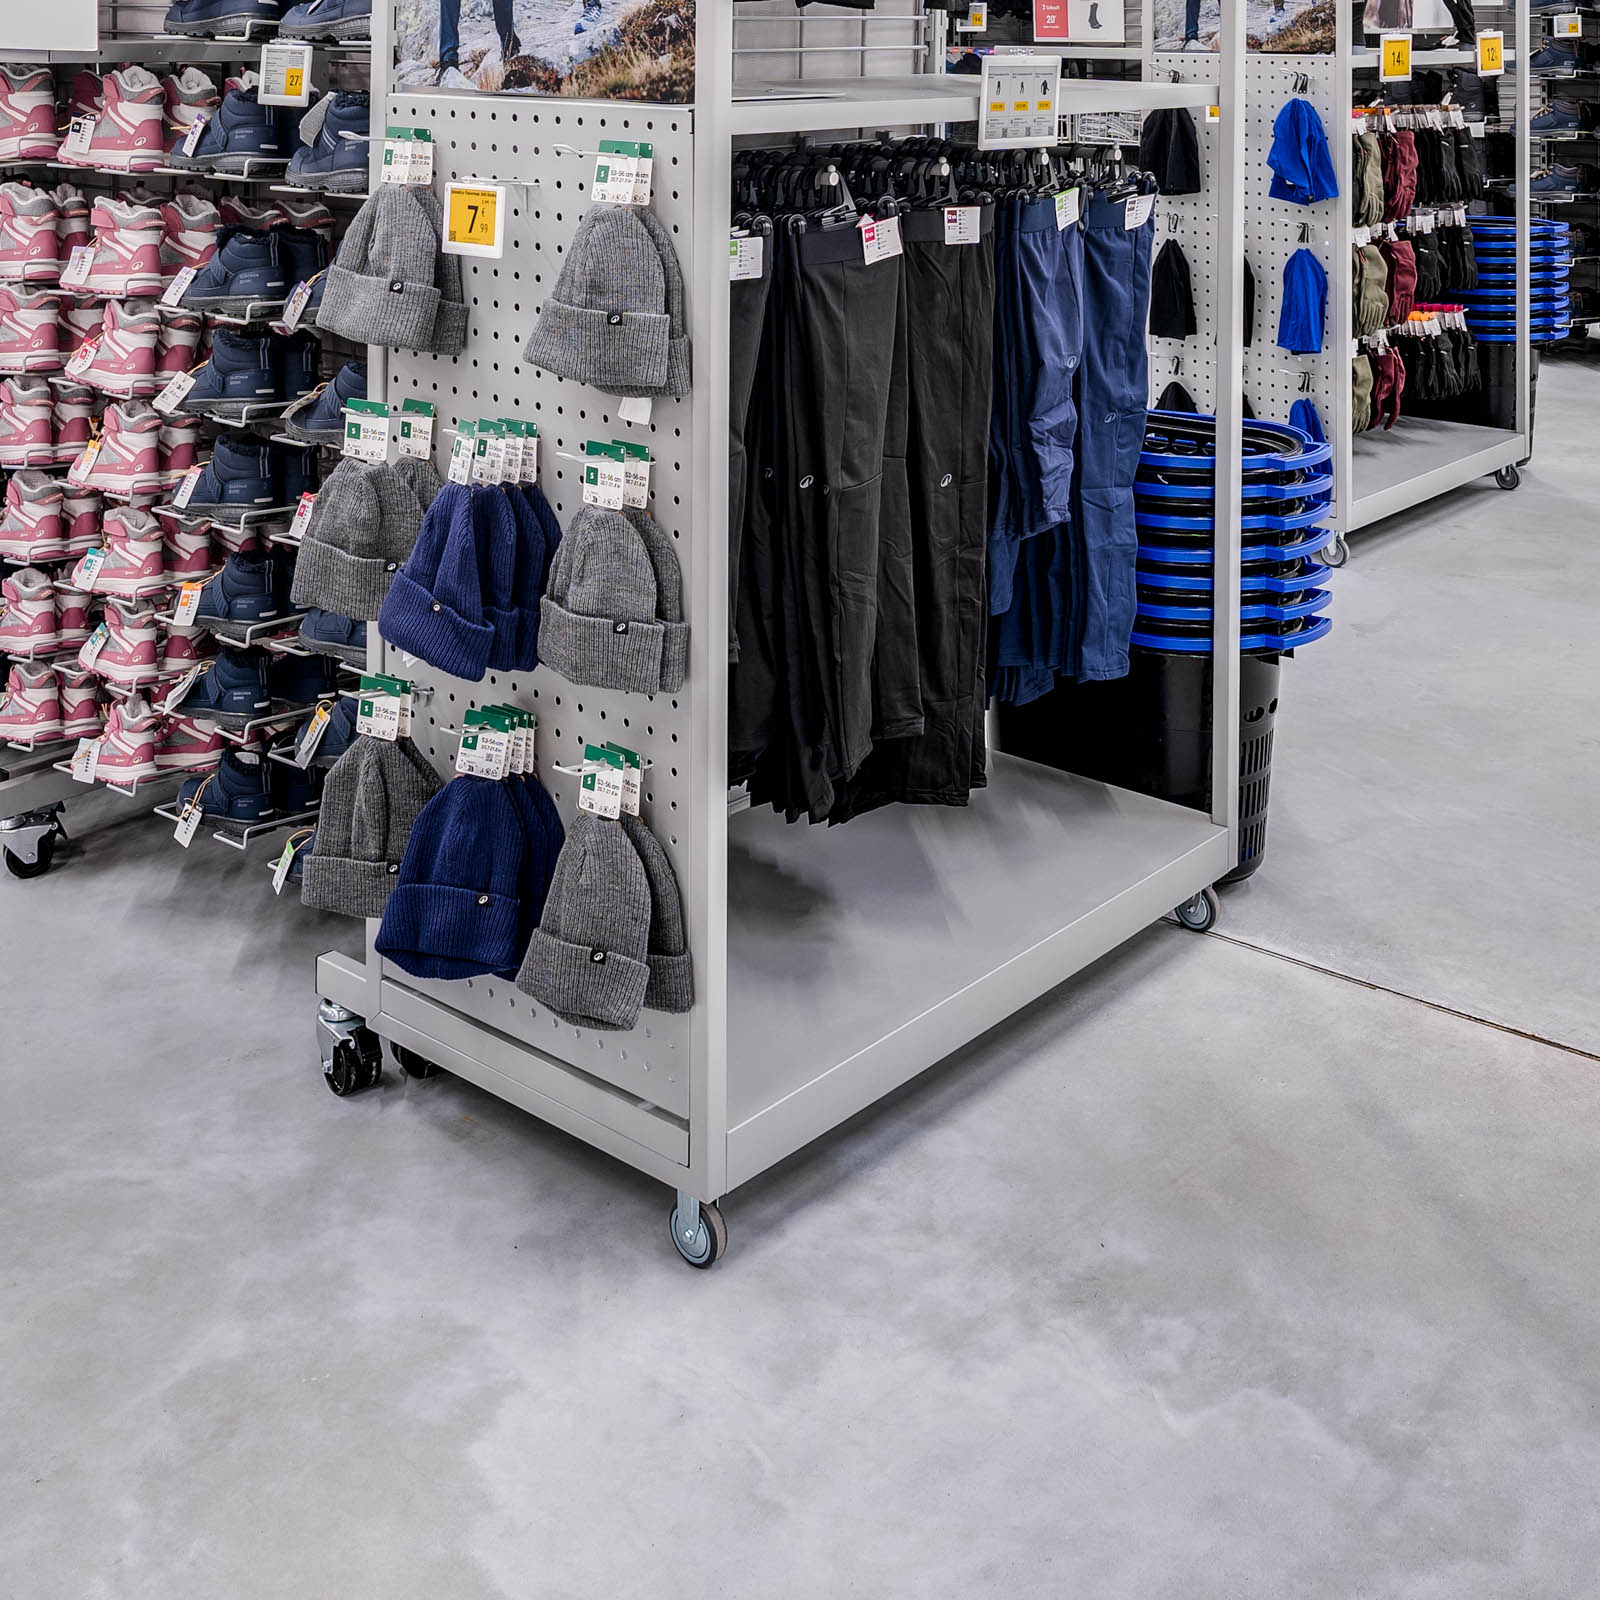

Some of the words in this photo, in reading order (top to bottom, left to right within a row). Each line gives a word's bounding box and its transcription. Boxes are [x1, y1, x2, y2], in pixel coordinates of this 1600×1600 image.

[1391, 51, 1401, 66] 14
[1487, 48, 1495, 61] 12
[289, 75, 300, 86] 27
[467, 205, 478, 234] 7
[480, 223, 488, 232] 99
